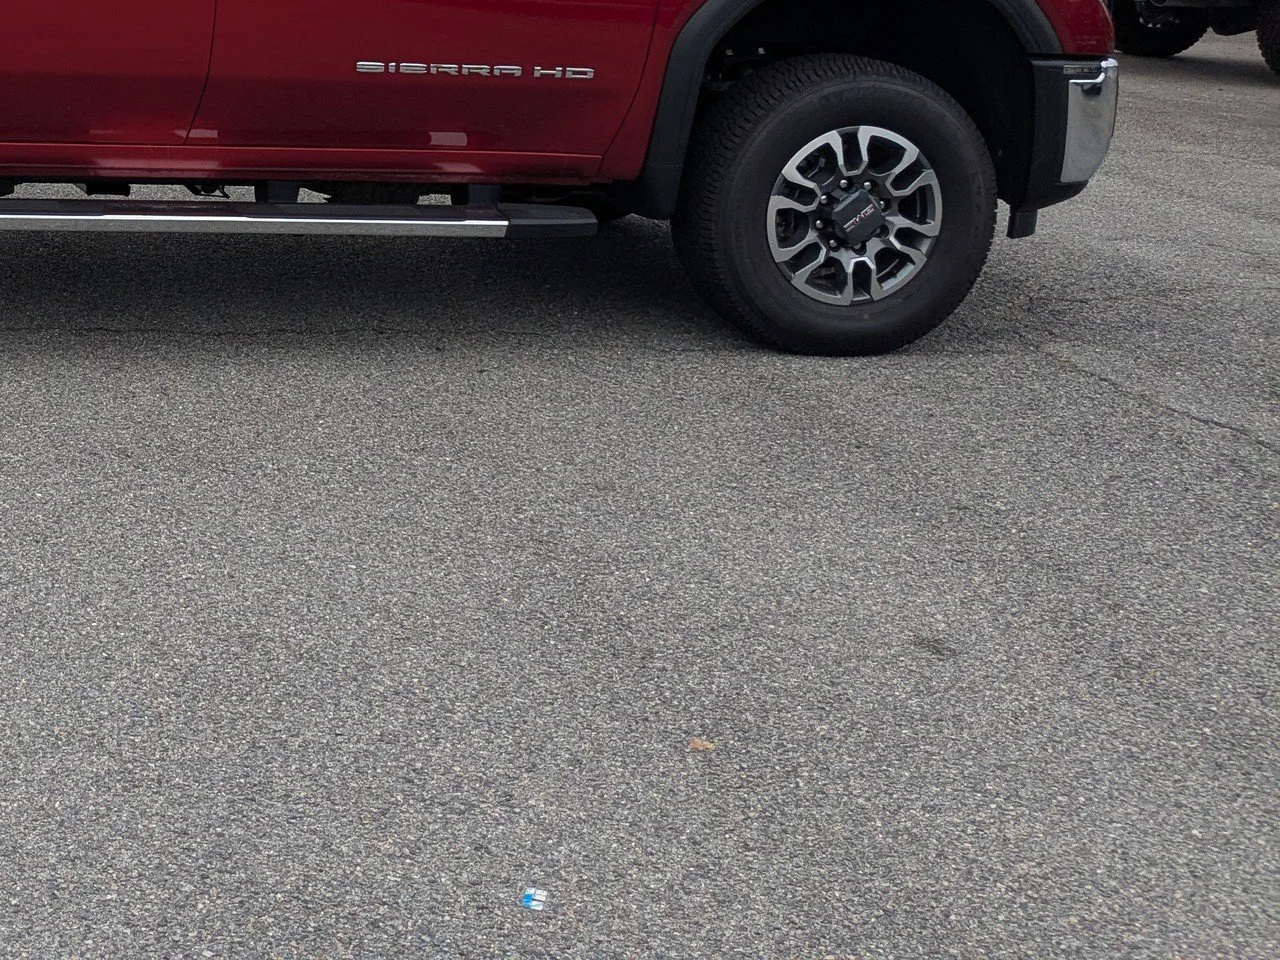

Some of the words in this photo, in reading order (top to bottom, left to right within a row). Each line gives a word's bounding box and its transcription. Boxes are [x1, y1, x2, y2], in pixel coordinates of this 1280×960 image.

[356, 61, 523, 77] SIERRA
[533, 66, 595, 79] HD
[843, 204, 875, 232] GMC
